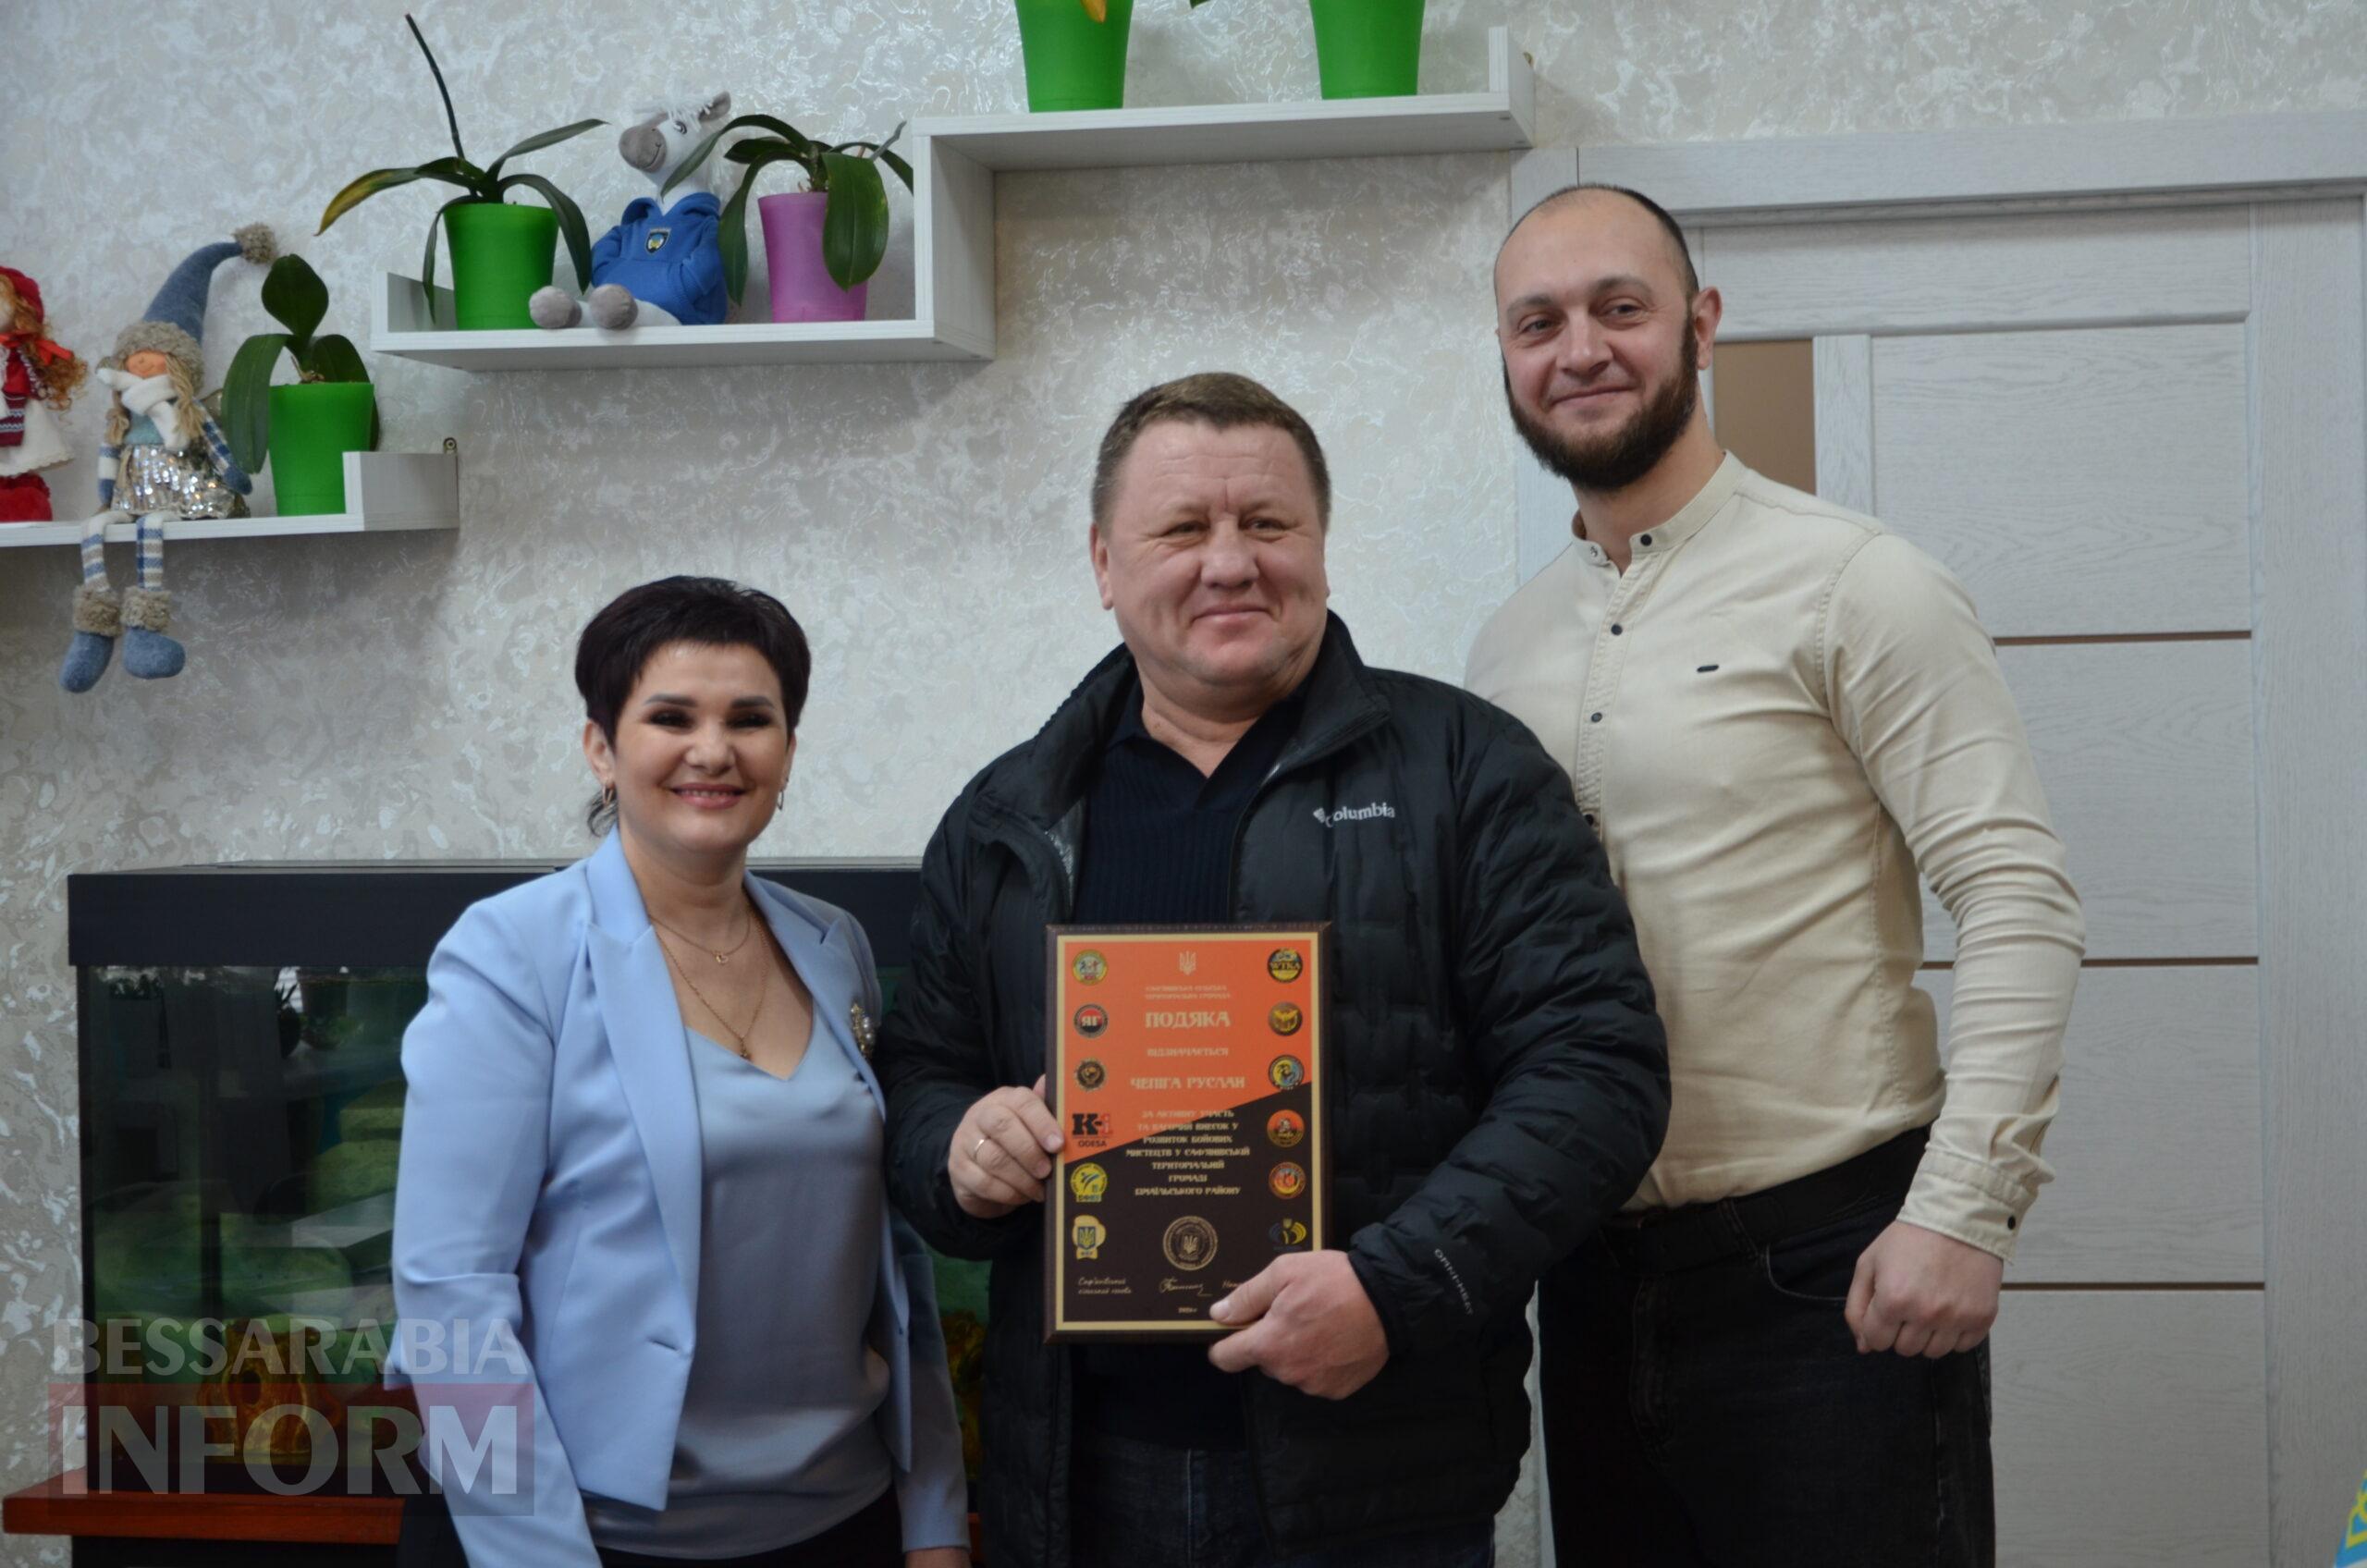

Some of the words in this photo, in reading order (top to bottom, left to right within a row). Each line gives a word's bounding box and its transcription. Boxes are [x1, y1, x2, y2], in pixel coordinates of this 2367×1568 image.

[1325, 802, 1395, 828] Columbia
[1145, 1011, 1232, 1029] ПОДЯКА
[1186, 1076, 1245, 1089] РУСЛАН
[1199, 1109, 1234, 1118] УЧАСТЬ
